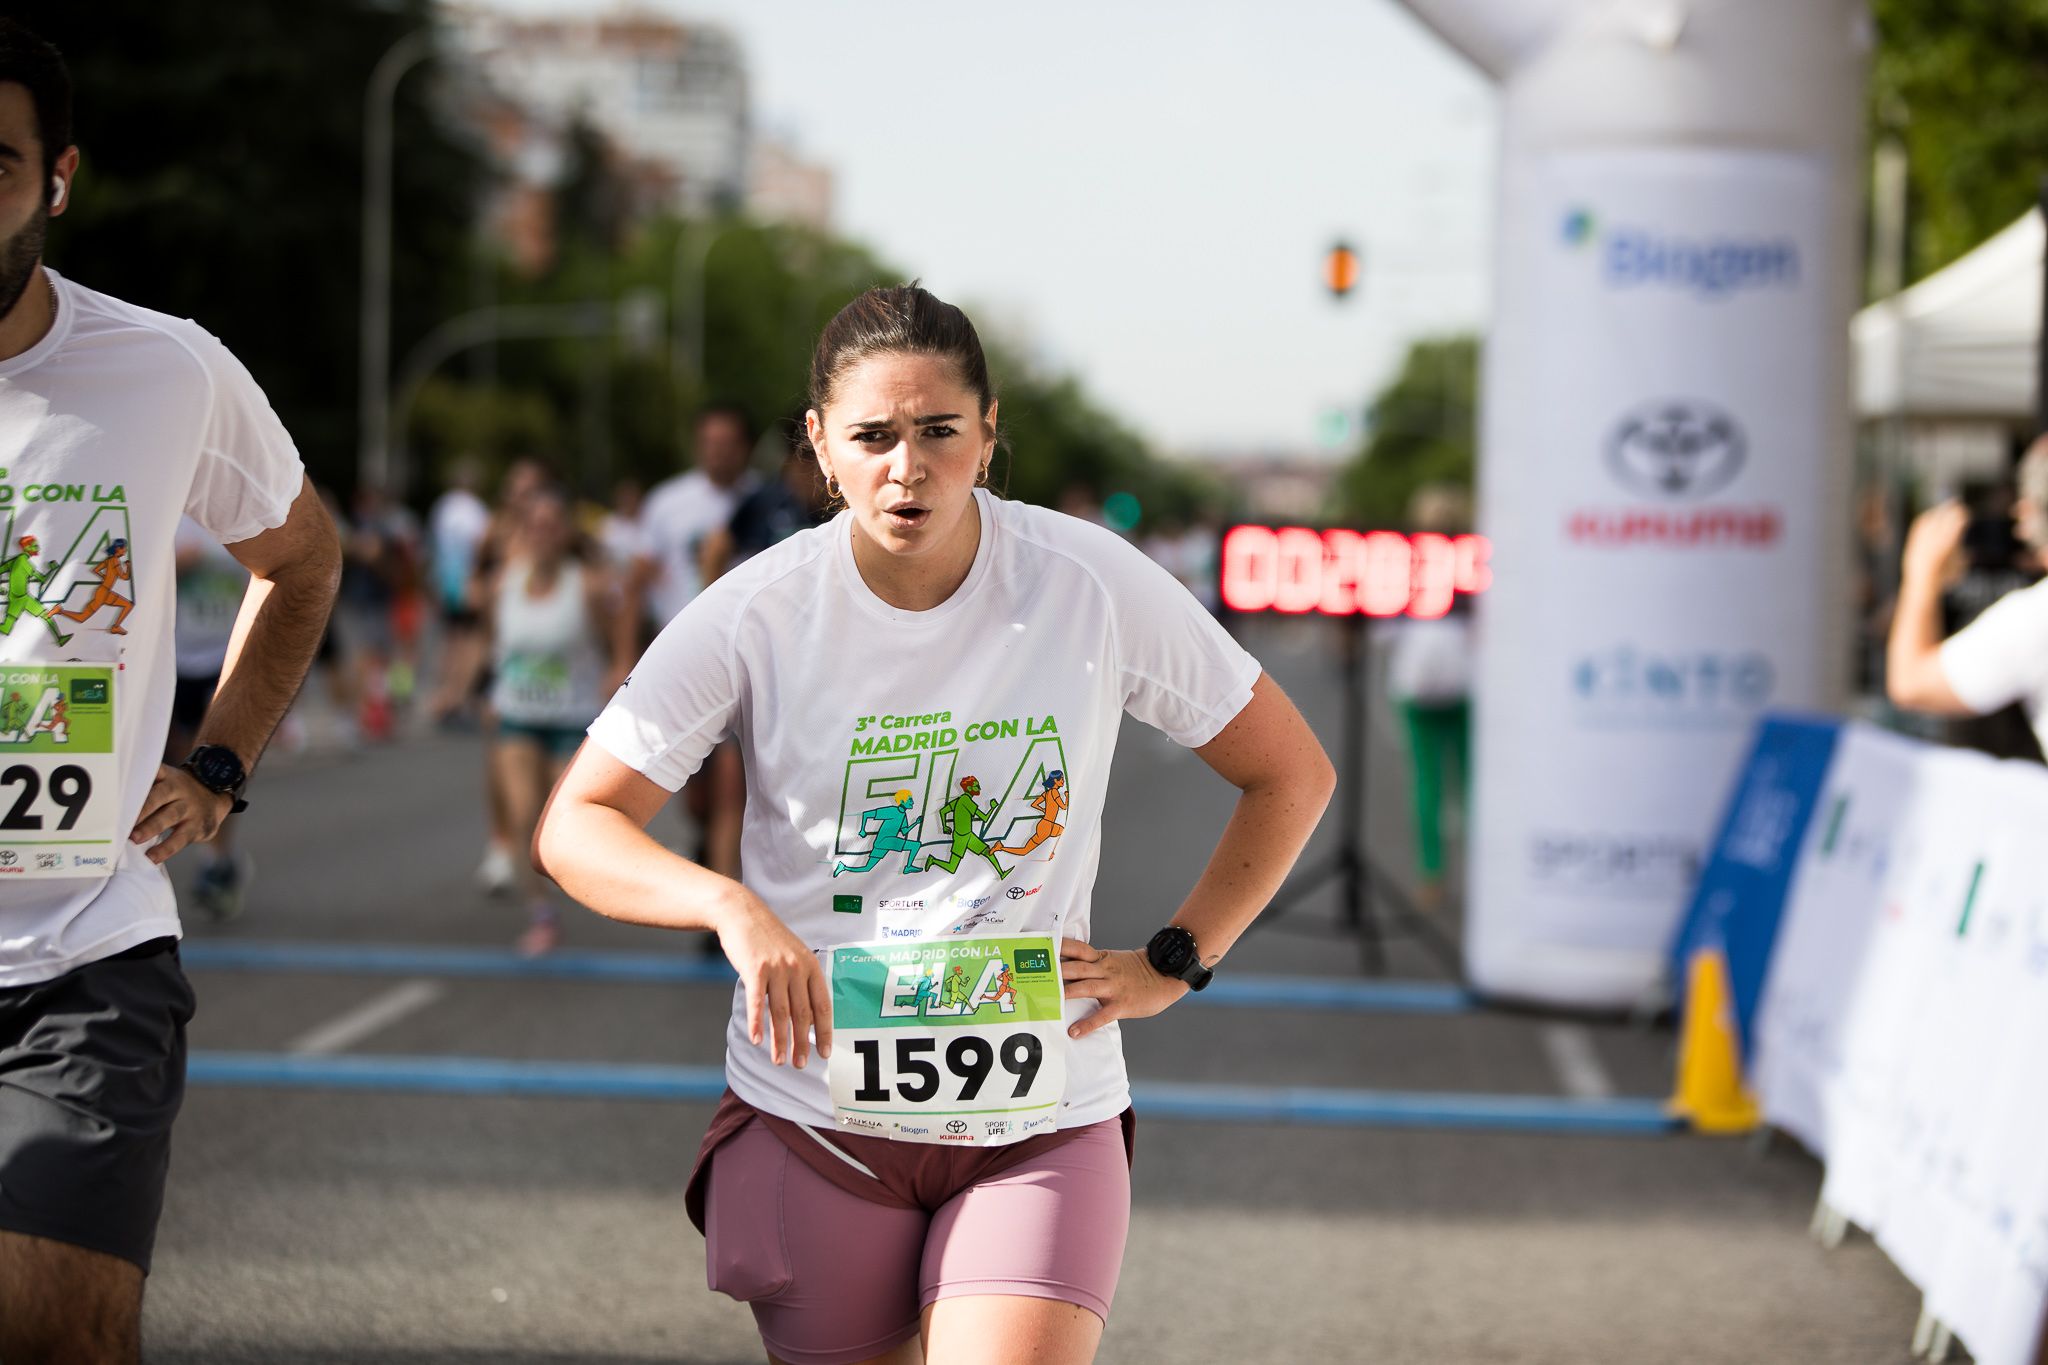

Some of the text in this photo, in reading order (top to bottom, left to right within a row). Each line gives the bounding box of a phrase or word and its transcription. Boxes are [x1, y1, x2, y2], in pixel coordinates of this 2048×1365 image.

[23, 483, 86, 502] CON
[92, 484, 127, 502] LA
[8, 673, 40, 685] CON
[44, 673, 59, 684] LA
[880, 711, 952, 729] Carrera
[850, 715, 1058, 756] MADRID CON LA
[835, 737, 1070, 856] ELA
[957, 896, 991, 909] Biogen
[891, 929, 923, 937] MADRID
[852, 954, 886, 963] Carrera
[889, 946, 946, 962] MADRID
[951, 946, 983, 959] CON
[984, 946, 1002, 958] LA
[1020, 959, 1046, 969] adELA
[879, 958, 1015, 1019] ELA
[854, 1032, 1043, 1102] 1599
[901, 1125, 929, 1134] Biogen
[988, 1128, 1006, 1136] LIFE
